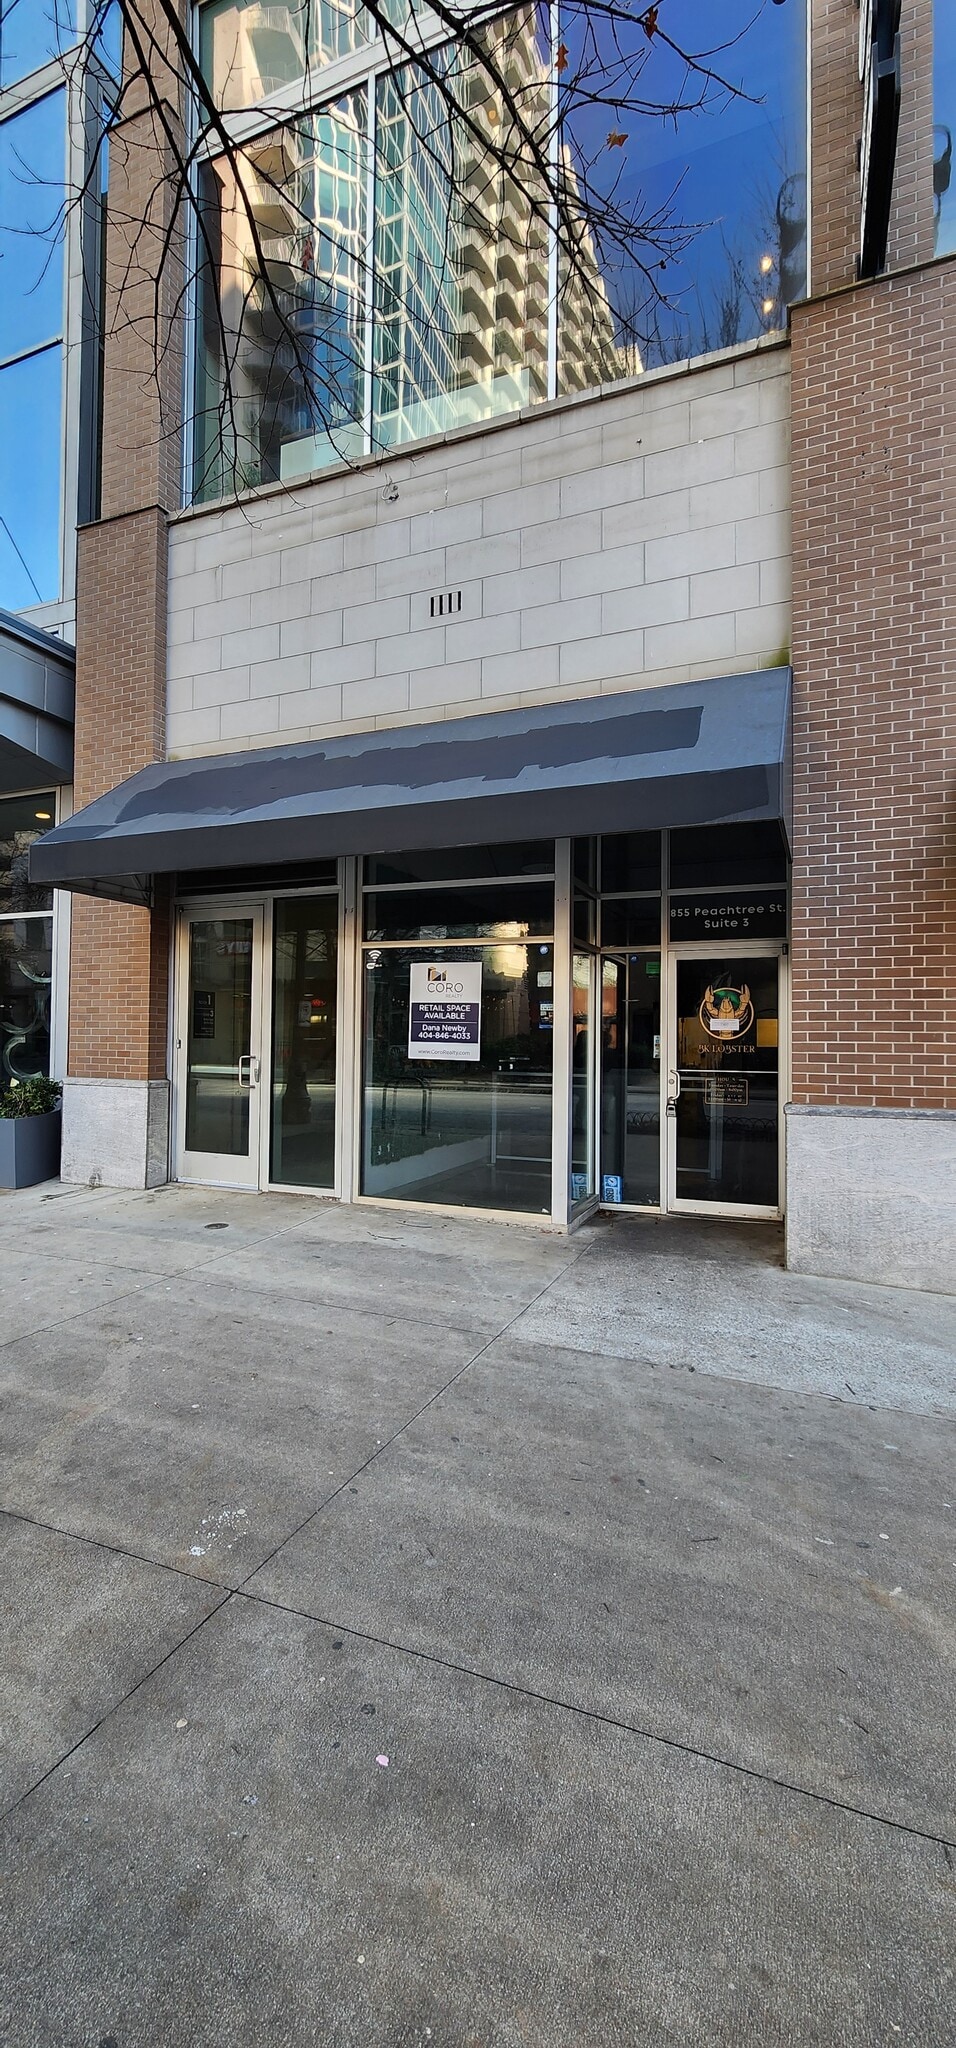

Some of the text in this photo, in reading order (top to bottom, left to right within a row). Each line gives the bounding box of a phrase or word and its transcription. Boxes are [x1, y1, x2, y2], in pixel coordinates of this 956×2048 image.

[670, 903, 786, 917] 855 Peachtree St.
[704, 918, 750, 929] Suite 3
[427, 982, 463, 993] CORO
[419, 1004, 471, 1012] RETAIL SPACE
[698, 1044, 756, 1055] BK LOBSTER
